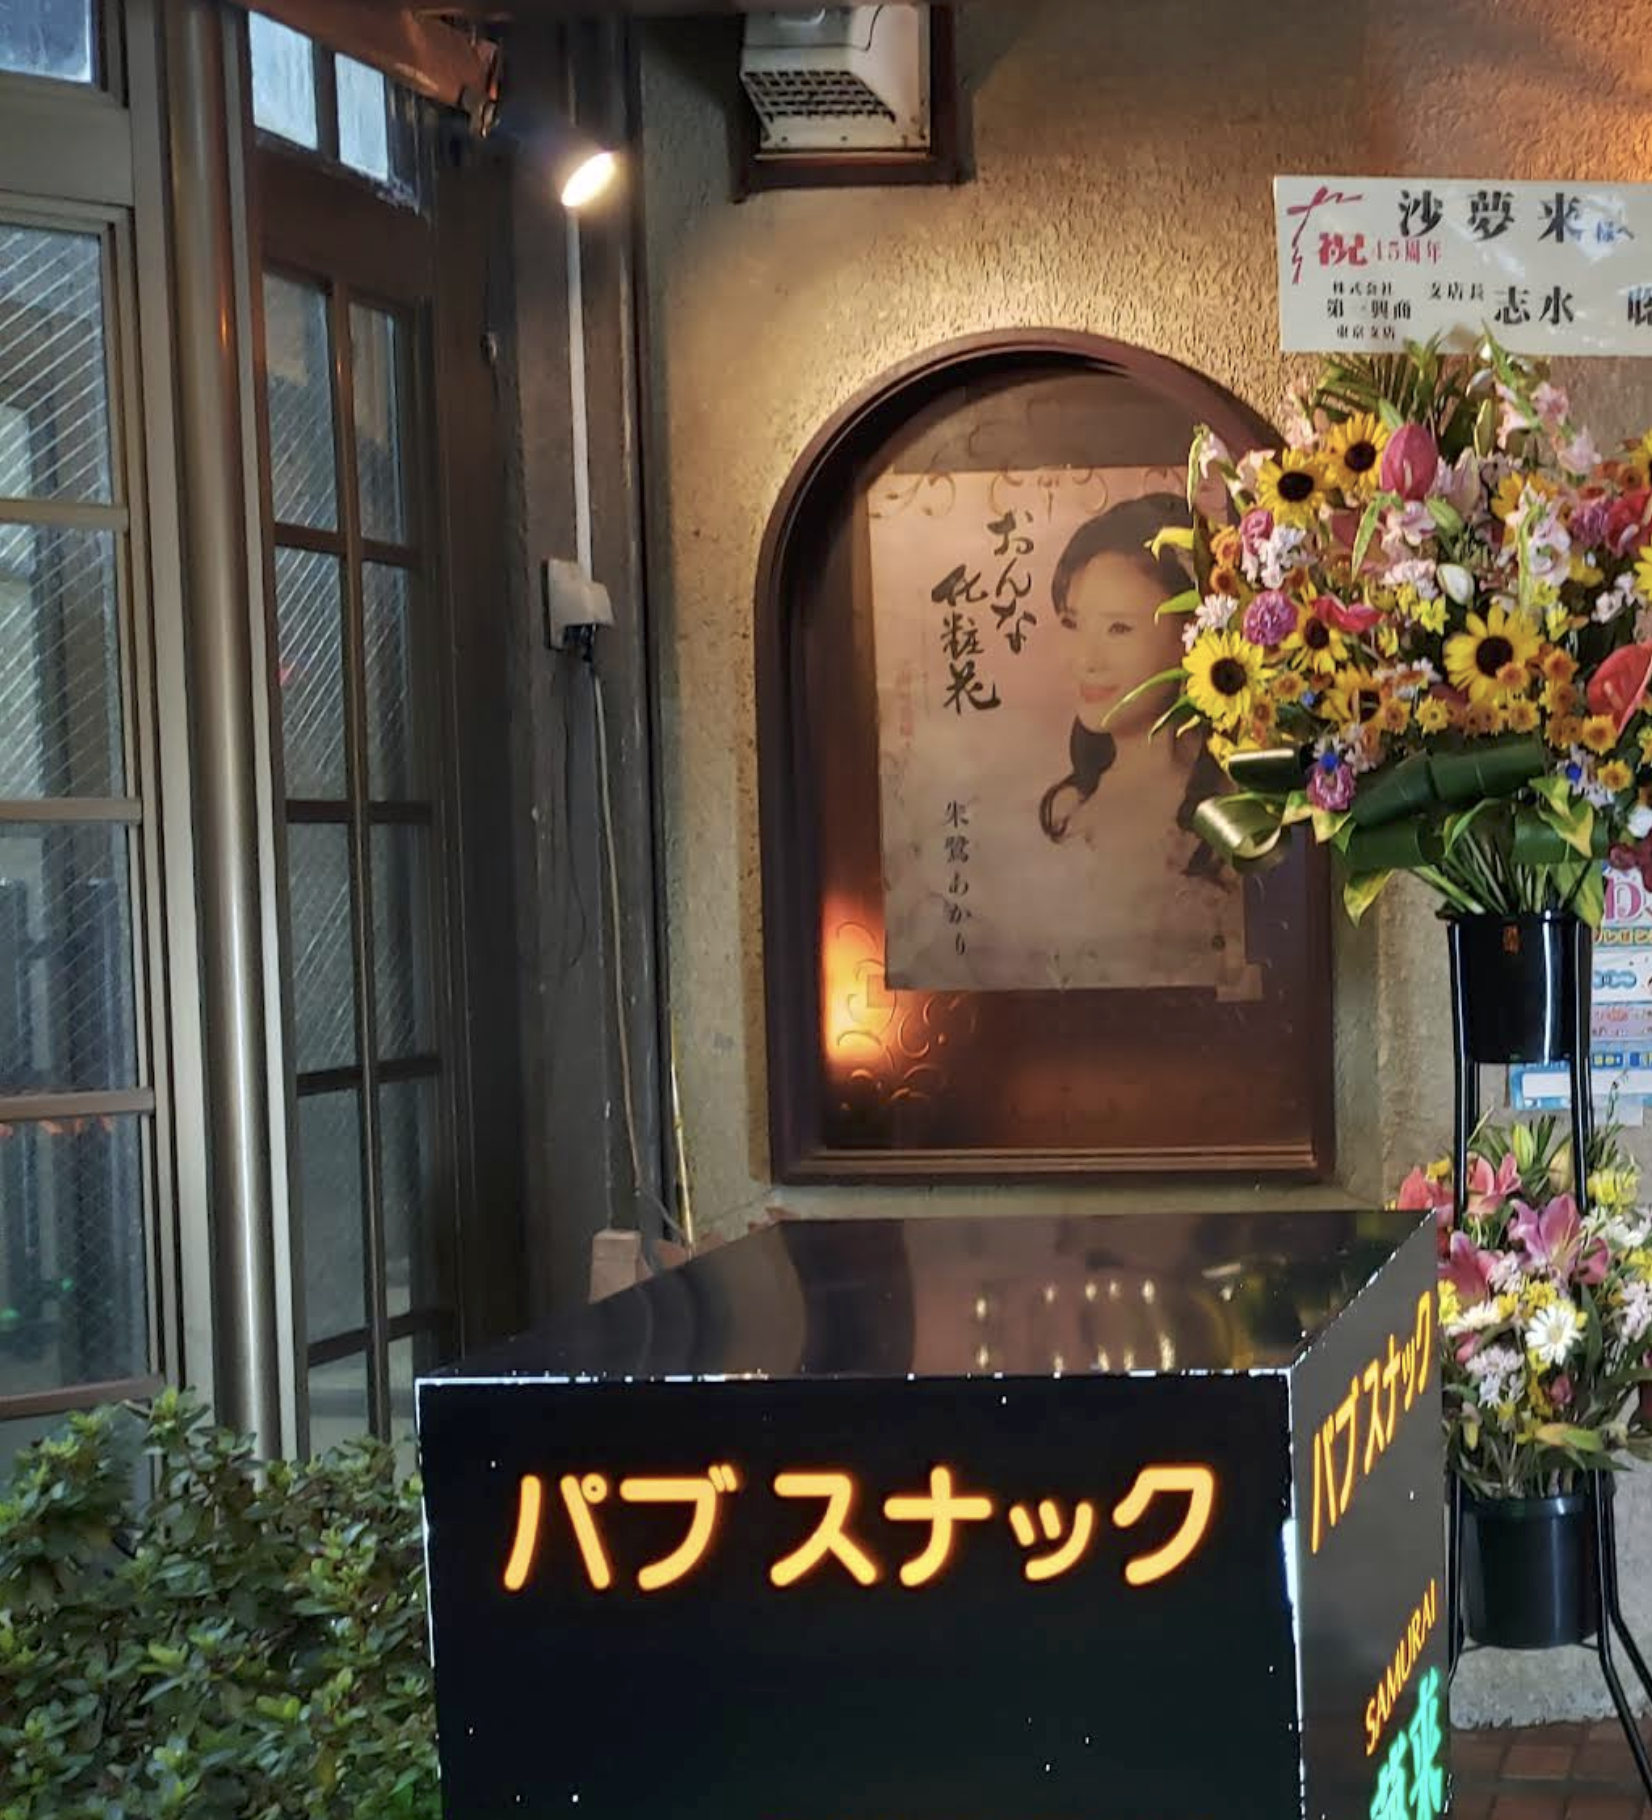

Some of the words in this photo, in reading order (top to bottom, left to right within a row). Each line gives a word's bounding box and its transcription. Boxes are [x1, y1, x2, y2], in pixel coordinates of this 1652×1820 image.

[1318, 232, 1368, 267] 祝
[1332, 281, 1393, 296] 株式会社
[931, 564, 1002, 716] 化粧花
[987, 508, 1038, 655] おんな
[1364, 1577, 1437, 1757] SAMURAI
